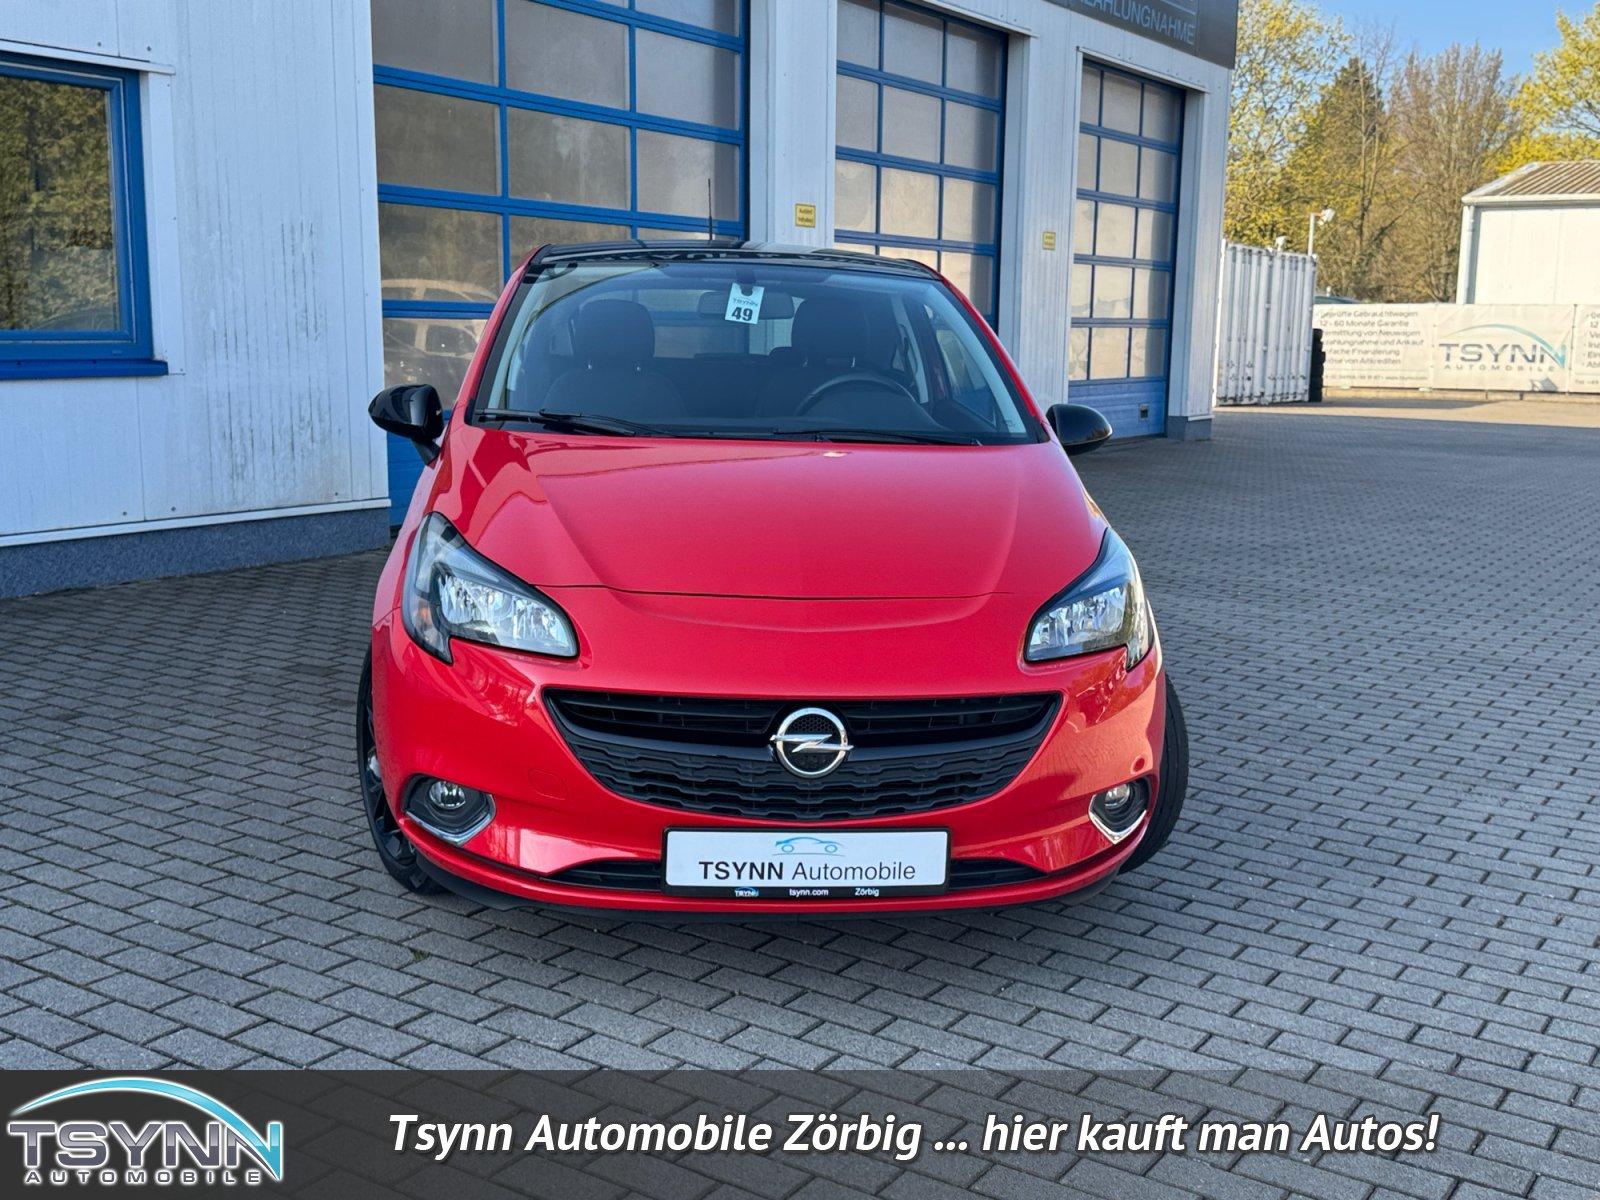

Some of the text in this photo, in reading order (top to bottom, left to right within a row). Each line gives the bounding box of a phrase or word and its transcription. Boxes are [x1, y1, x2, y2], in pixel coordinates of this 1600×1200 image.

[732, 307, 753, 321] 49
[1438, 343, 1567, 368] TSYNN
[1444, 364, 1555, 372] AUTOMOBILE
[699, 861, 916, 880] TSYNN Automobile
[789, 887, 829, 897] tsynn.com
[855, 887, 879, 897] Zörbig
